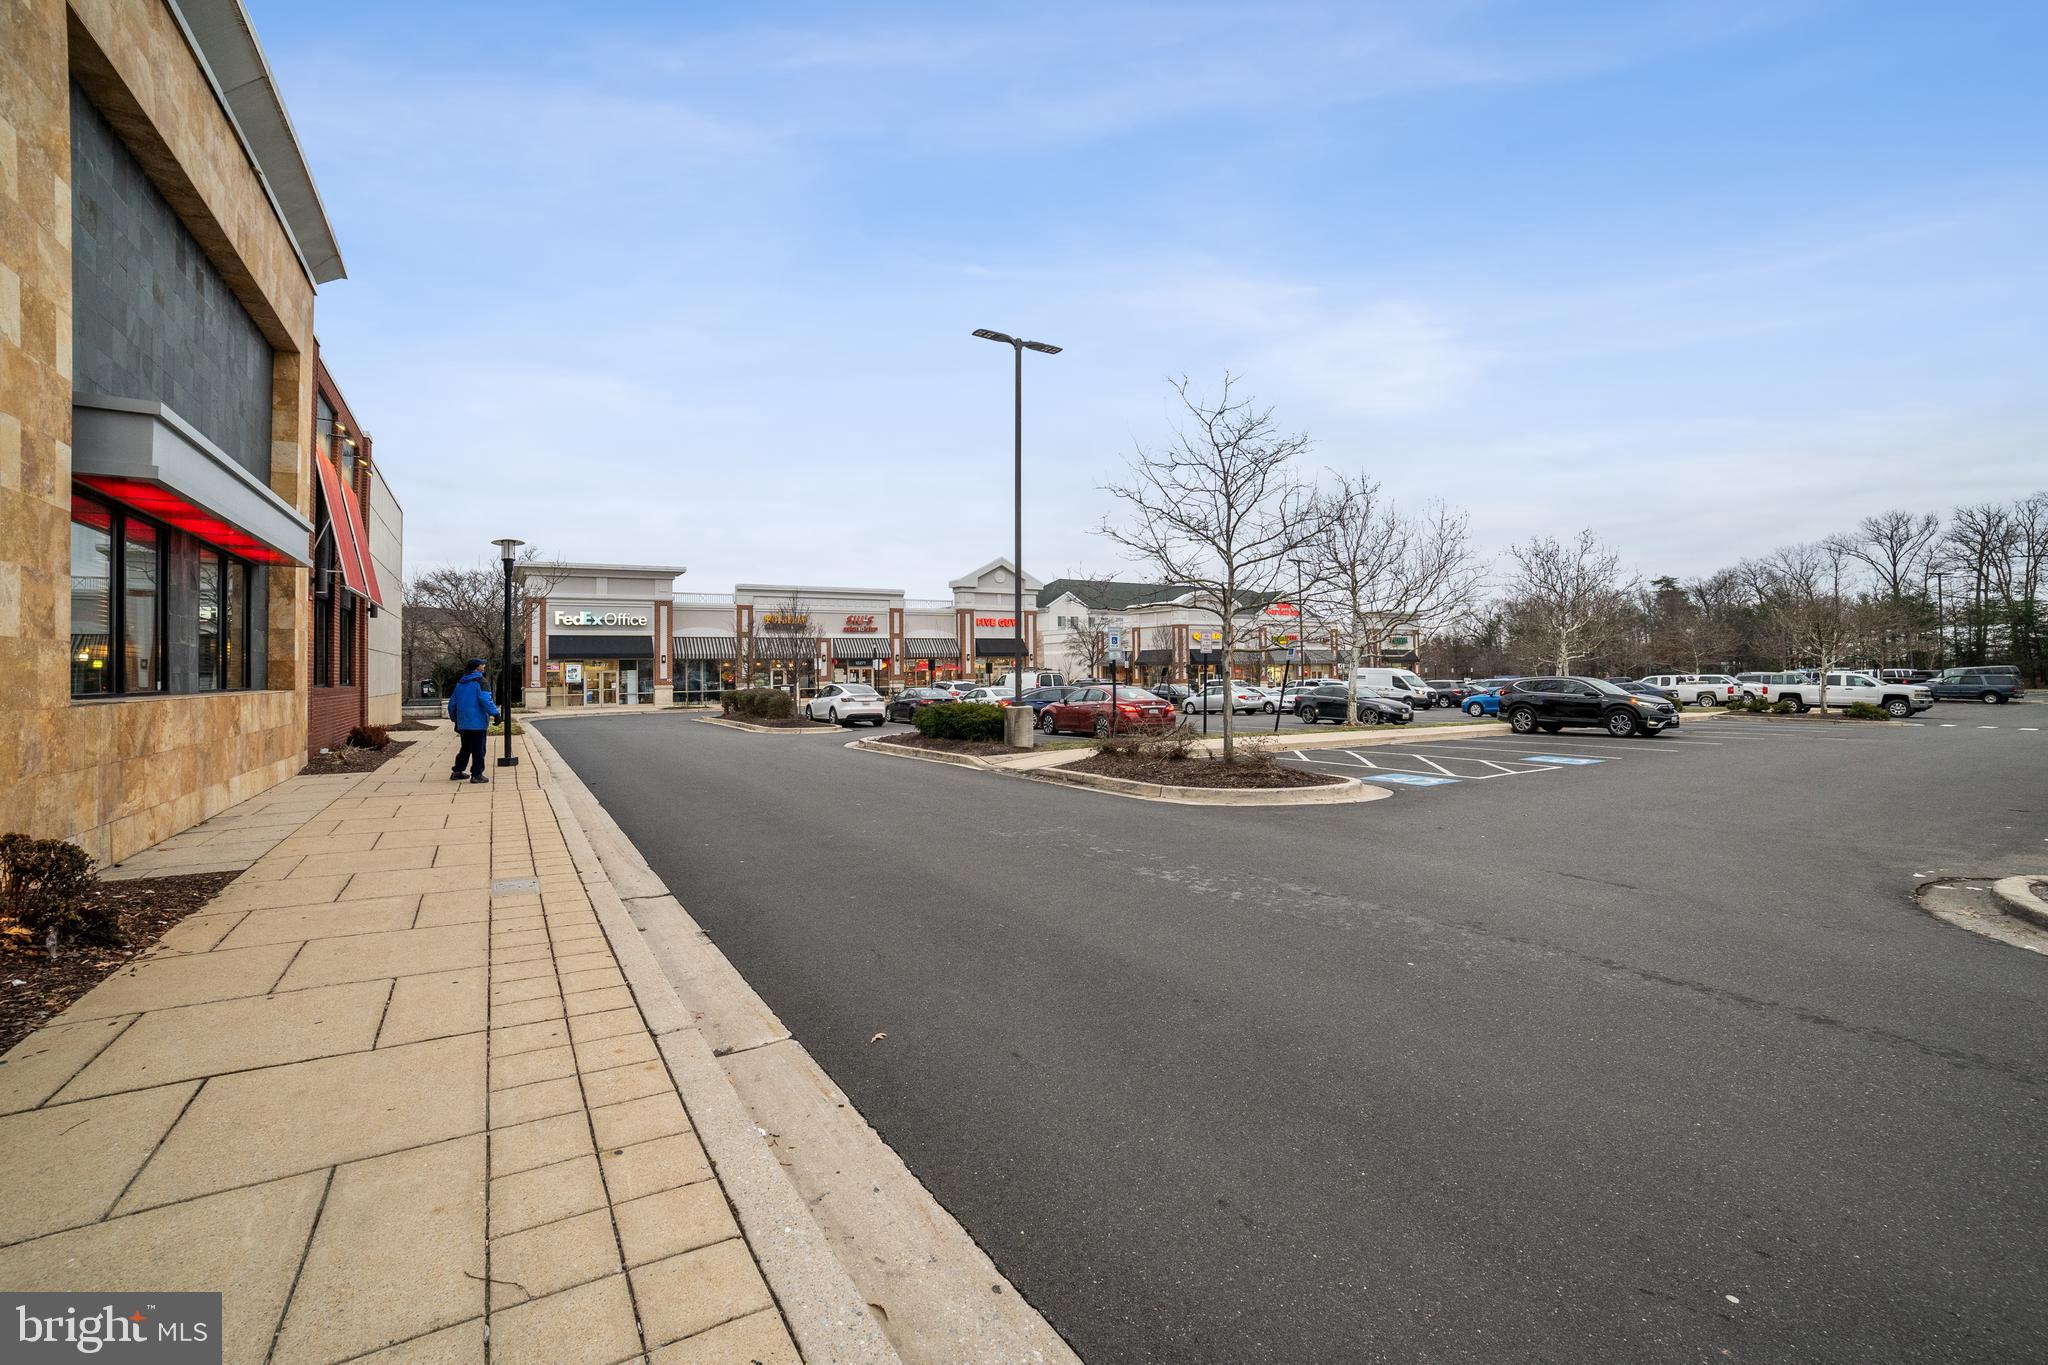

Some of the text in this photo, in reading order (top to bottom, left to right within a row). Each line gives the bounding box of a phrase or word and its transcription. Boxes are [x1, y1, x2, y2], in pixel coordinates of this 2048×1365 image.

[554, 610, 648, 626] FedEx Office
[976, 617, 1017, 627] FIVE GUY
